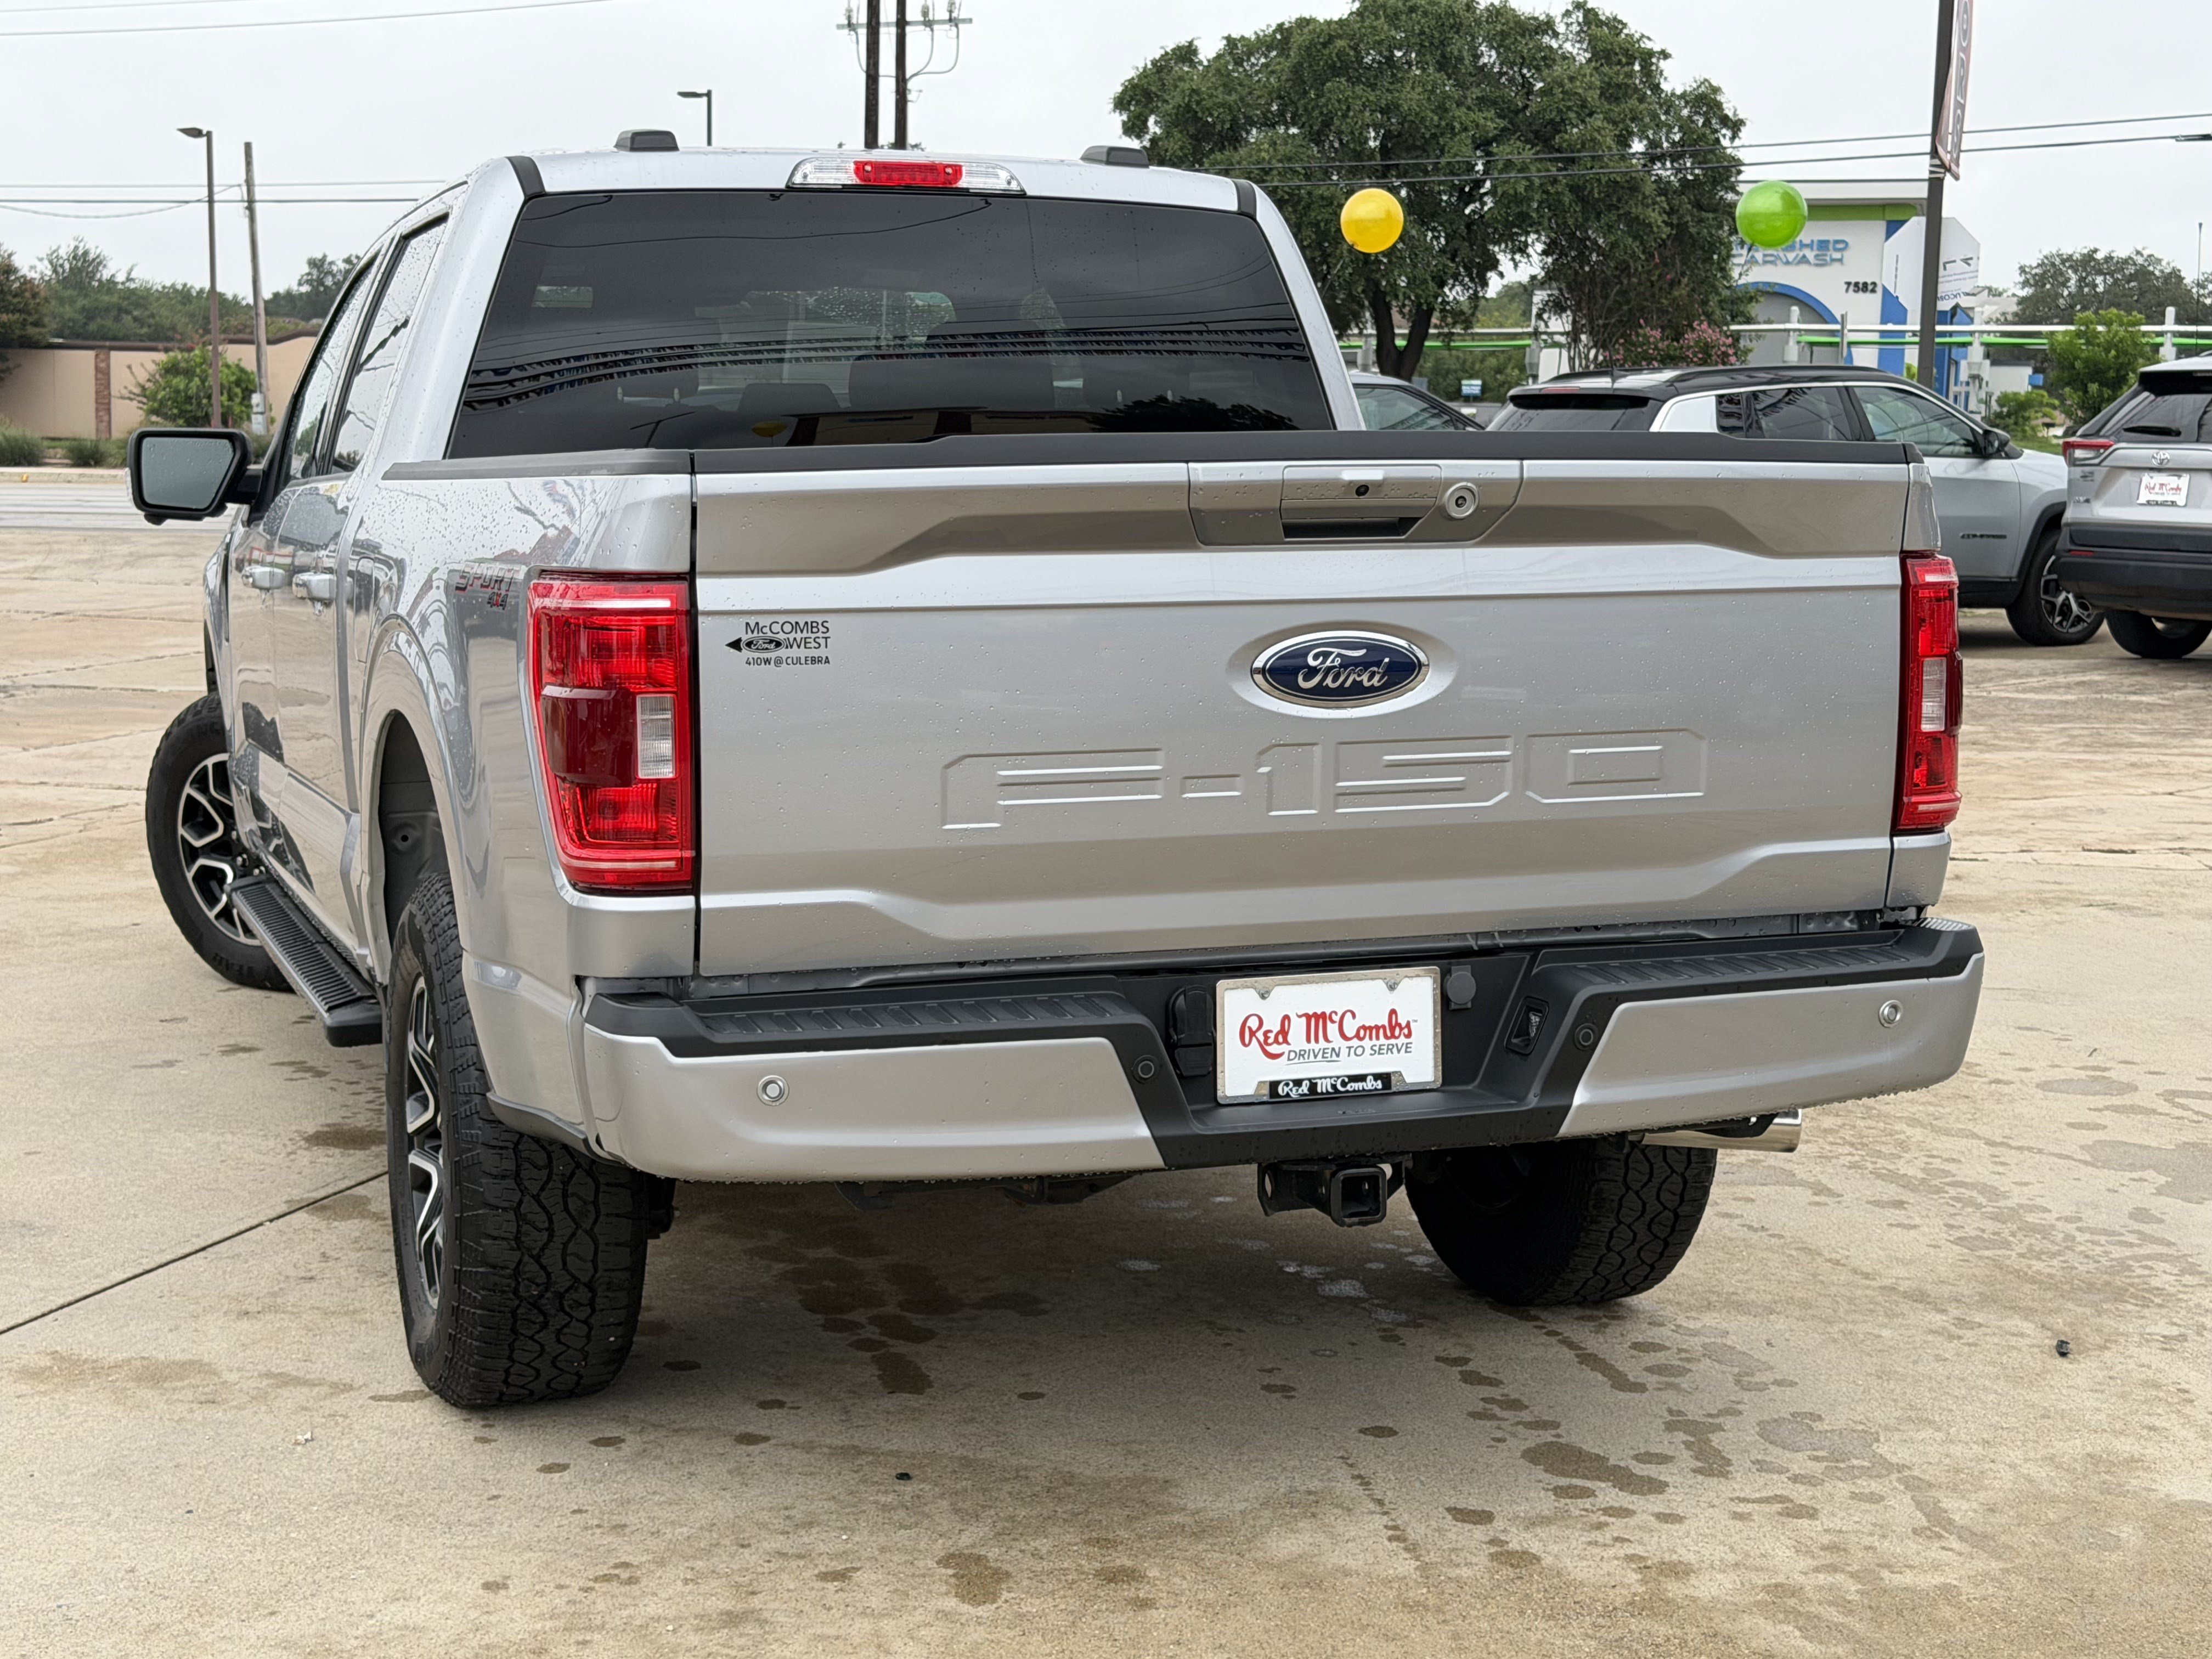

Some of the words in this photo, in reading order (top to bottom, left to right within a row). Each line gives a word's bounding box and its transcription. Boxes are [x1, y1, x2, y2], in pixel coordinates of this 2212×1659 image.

[1844, 281, 1877, 294] 7582
[455, 563, 520, 593] SPORT
[745, 620, 830, 635] McCOMBS
[751, 639, 776, 650] Ford
[786, 636, 831, 650] WEST
[1297, 647, 1390, 689] Ford
[940, 728, 1706, 830] F-150
[1239, 1013, 1291, 1060] Red
[1295, 1008, 1413, 1045] McCombs
[1286, 1046, 1341, 1062] DRIVEN
[1346, 1045, 1365, 1058] TO
[1369, 1042, 1413, 1056] SERVE
[1278, 1080, 1310, 1098] Red
[1311, 1075, 1383, 1093] McCombs
